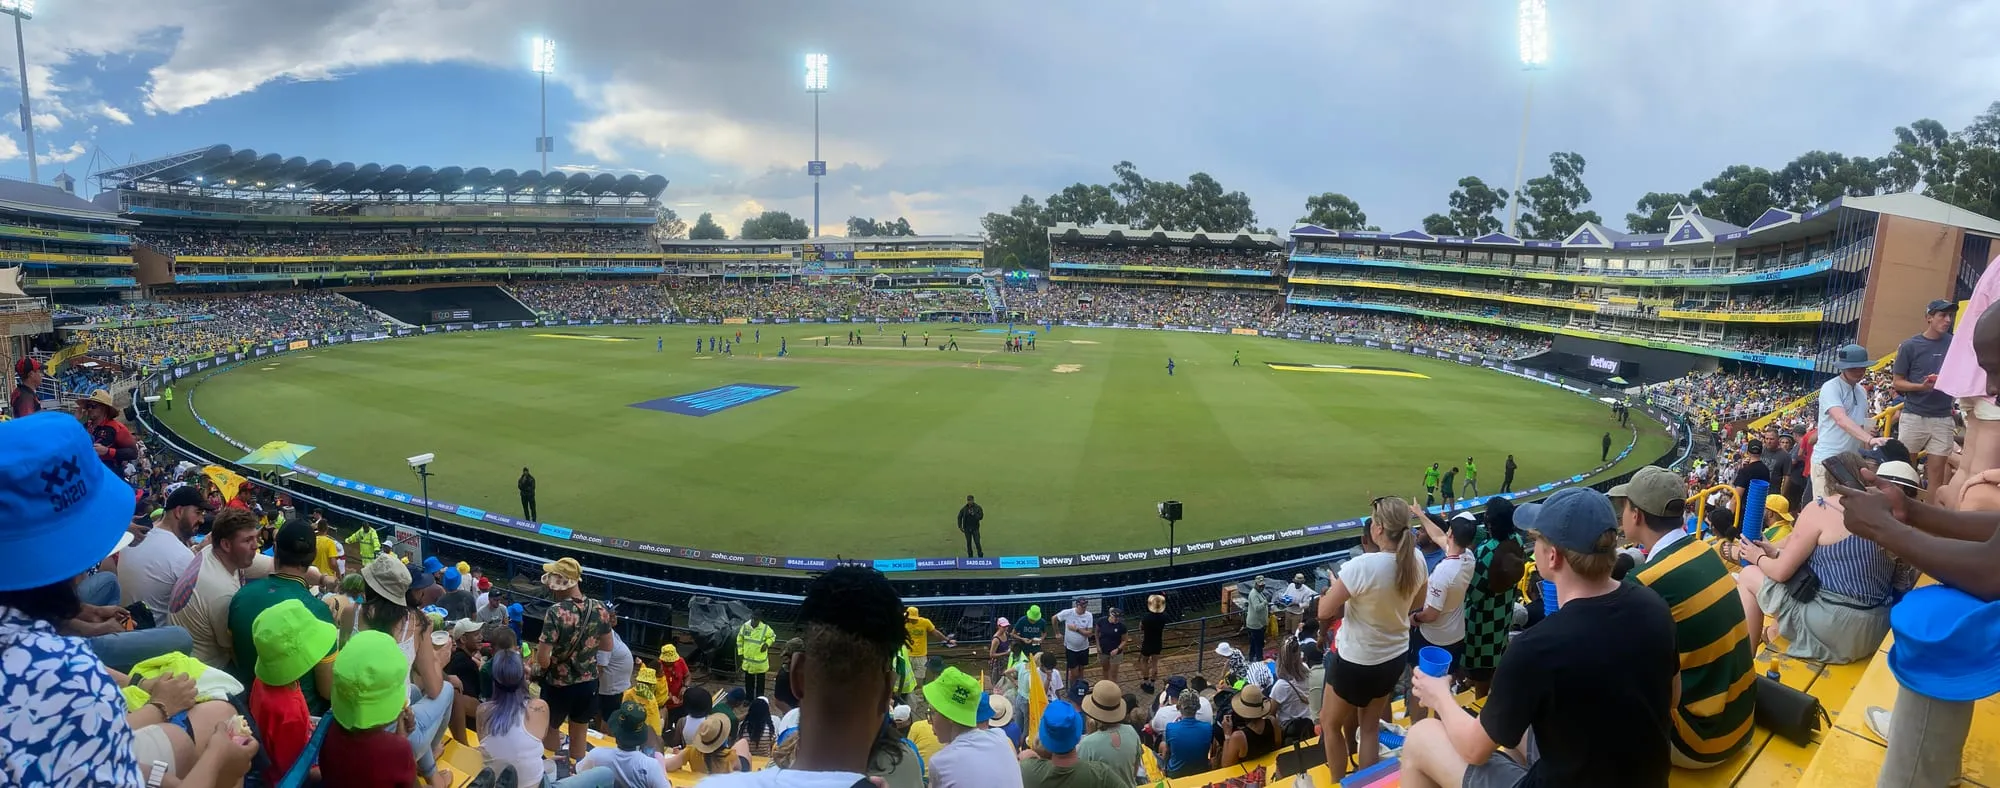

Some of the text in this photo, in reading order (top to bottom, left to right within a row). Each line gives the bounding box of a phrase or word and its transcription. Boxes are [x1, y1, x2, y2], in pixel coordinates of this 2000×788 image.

[1590, 354, 1618, 373] betway
[39, 454, 81, 493] XX
[51, 479, 87, 512] SA20
[572, 533, 602, 543] zoho.com
[1250, 533, 1275, 542] betway
[1279, 528, 1304, 538] betway
[1219, 537, 1245, 546] betway
[639, 544, 671, 553] zoho.com
[1153, 546, 1181, 556] betway
[1187, 542, 1214, 552] betway
[711, 552, 744, 562] zoho.com
[1080, 553, 1111, 562] betway
[1118, 551, 1148, 560] betway
[1042, 557, 1073, 566] betway
[955, 685, 971, 698] XX
